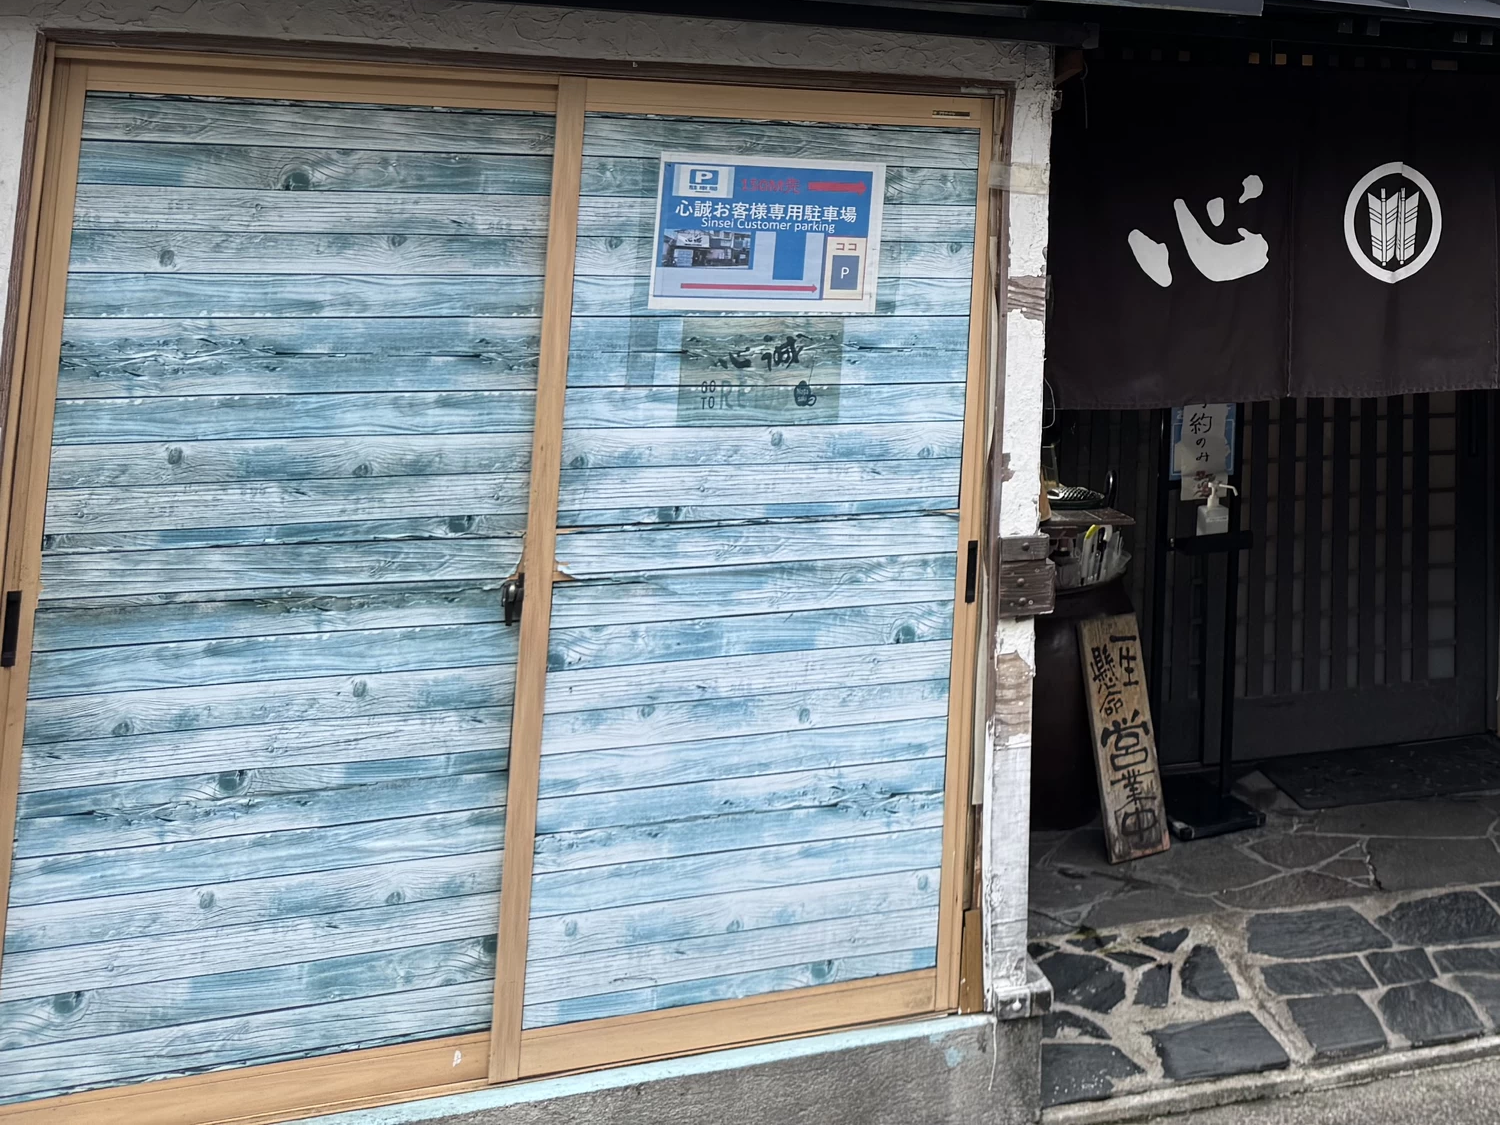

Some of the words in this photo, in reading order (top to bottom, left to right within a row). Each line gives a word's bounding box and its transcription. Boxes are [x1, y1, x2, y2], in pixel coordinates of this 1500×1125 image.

[675, 200, 857, 223] 心誠お客様専用駐車場
[701, 217, 734, 228] Sinsei
[737, 218, 791, 230] Customer
[794, 222, 835, 233] parking
[1127, 174, 1269, 287] 心
[841, 267, 850, 279] P
[701, 396, 715, 410] TO
[1190, 404, 1213, 462] 約のみ
